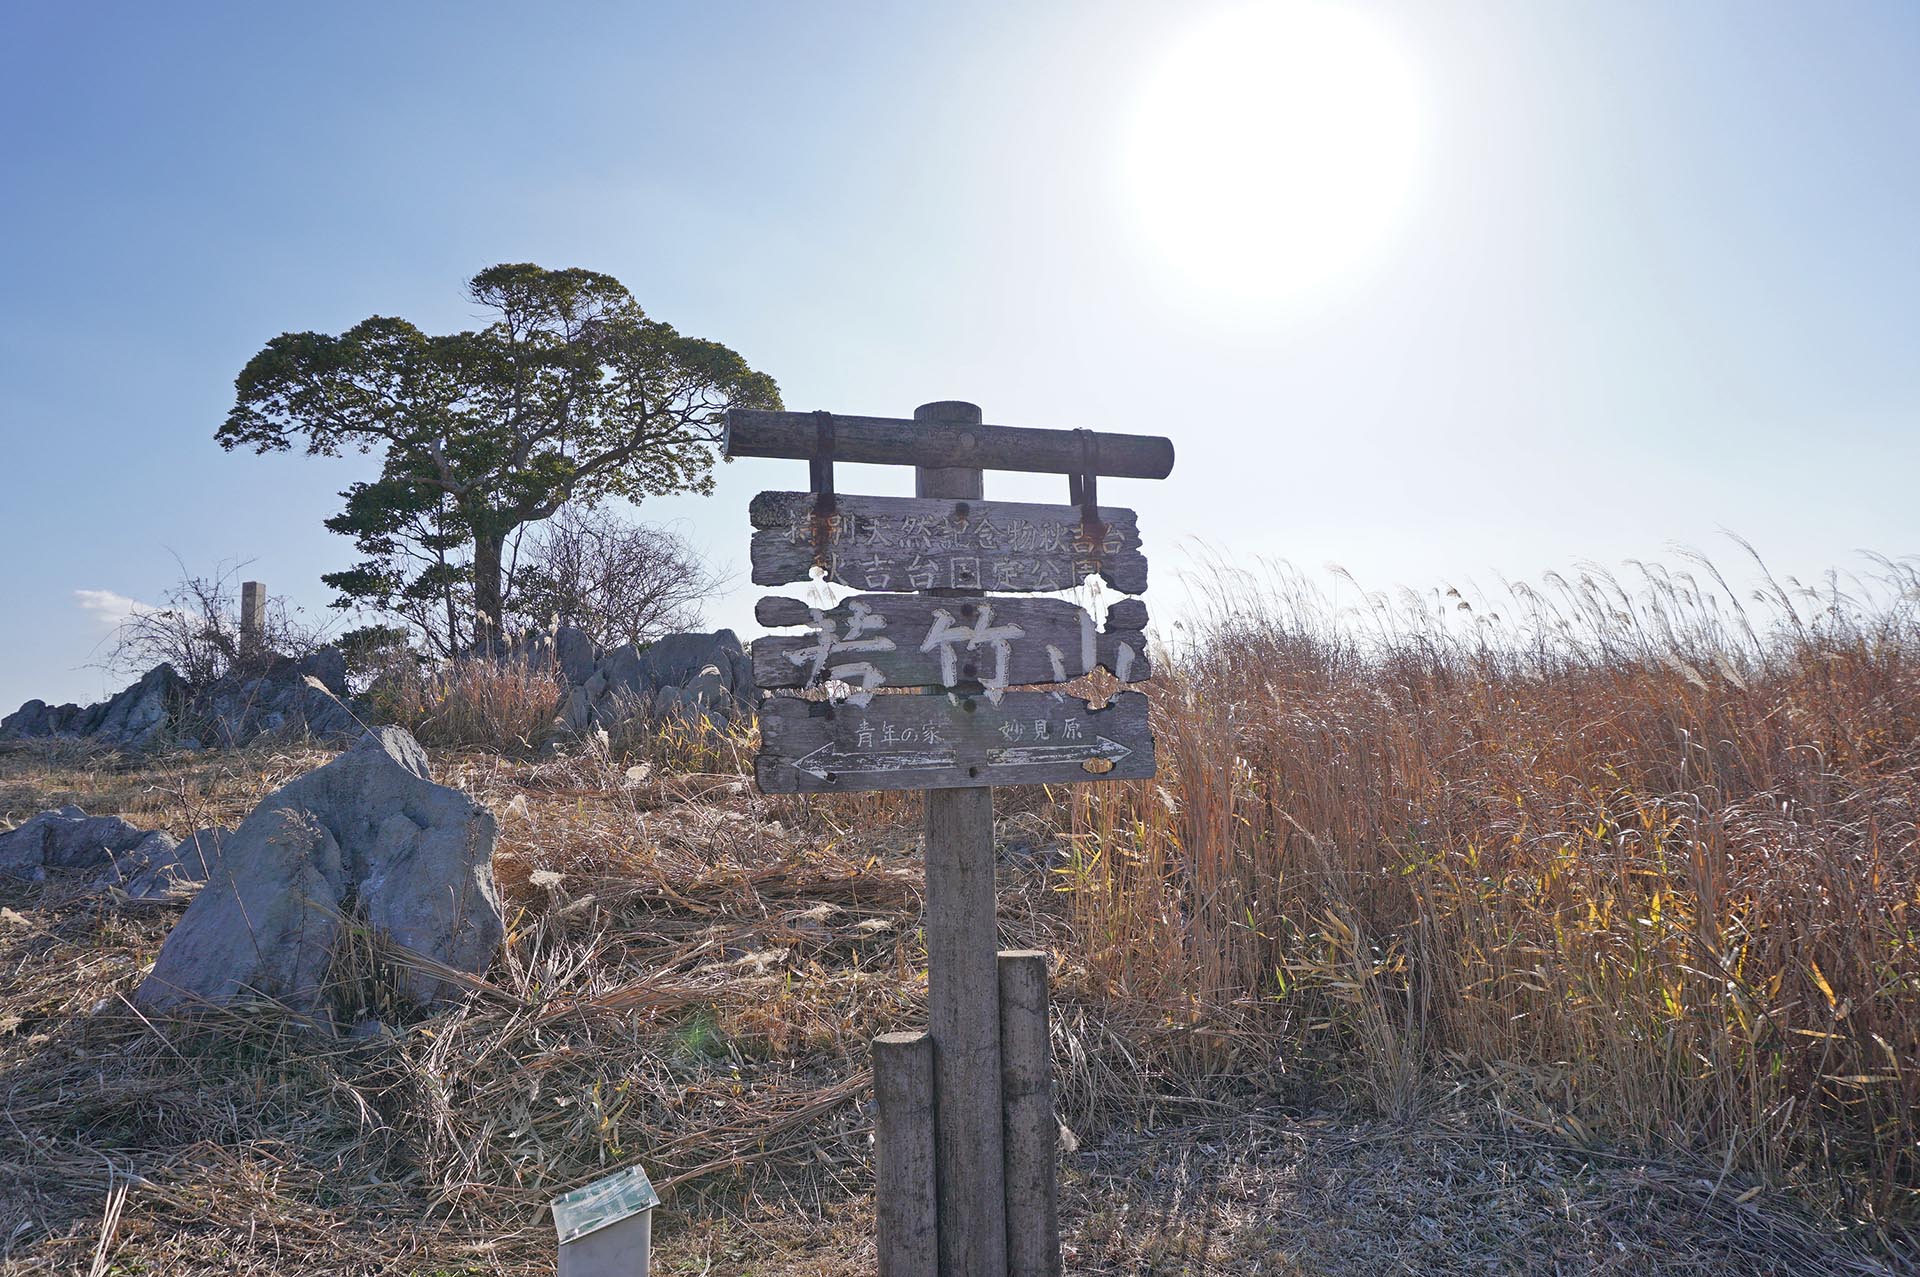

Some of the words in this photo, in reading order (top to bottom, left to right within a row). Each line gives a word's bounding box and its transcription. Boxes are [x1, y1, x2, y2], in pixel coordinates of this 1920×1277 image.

[855, 719, 945, 747] 青年の家
[998, 717, 1082, 742] 妙見原
